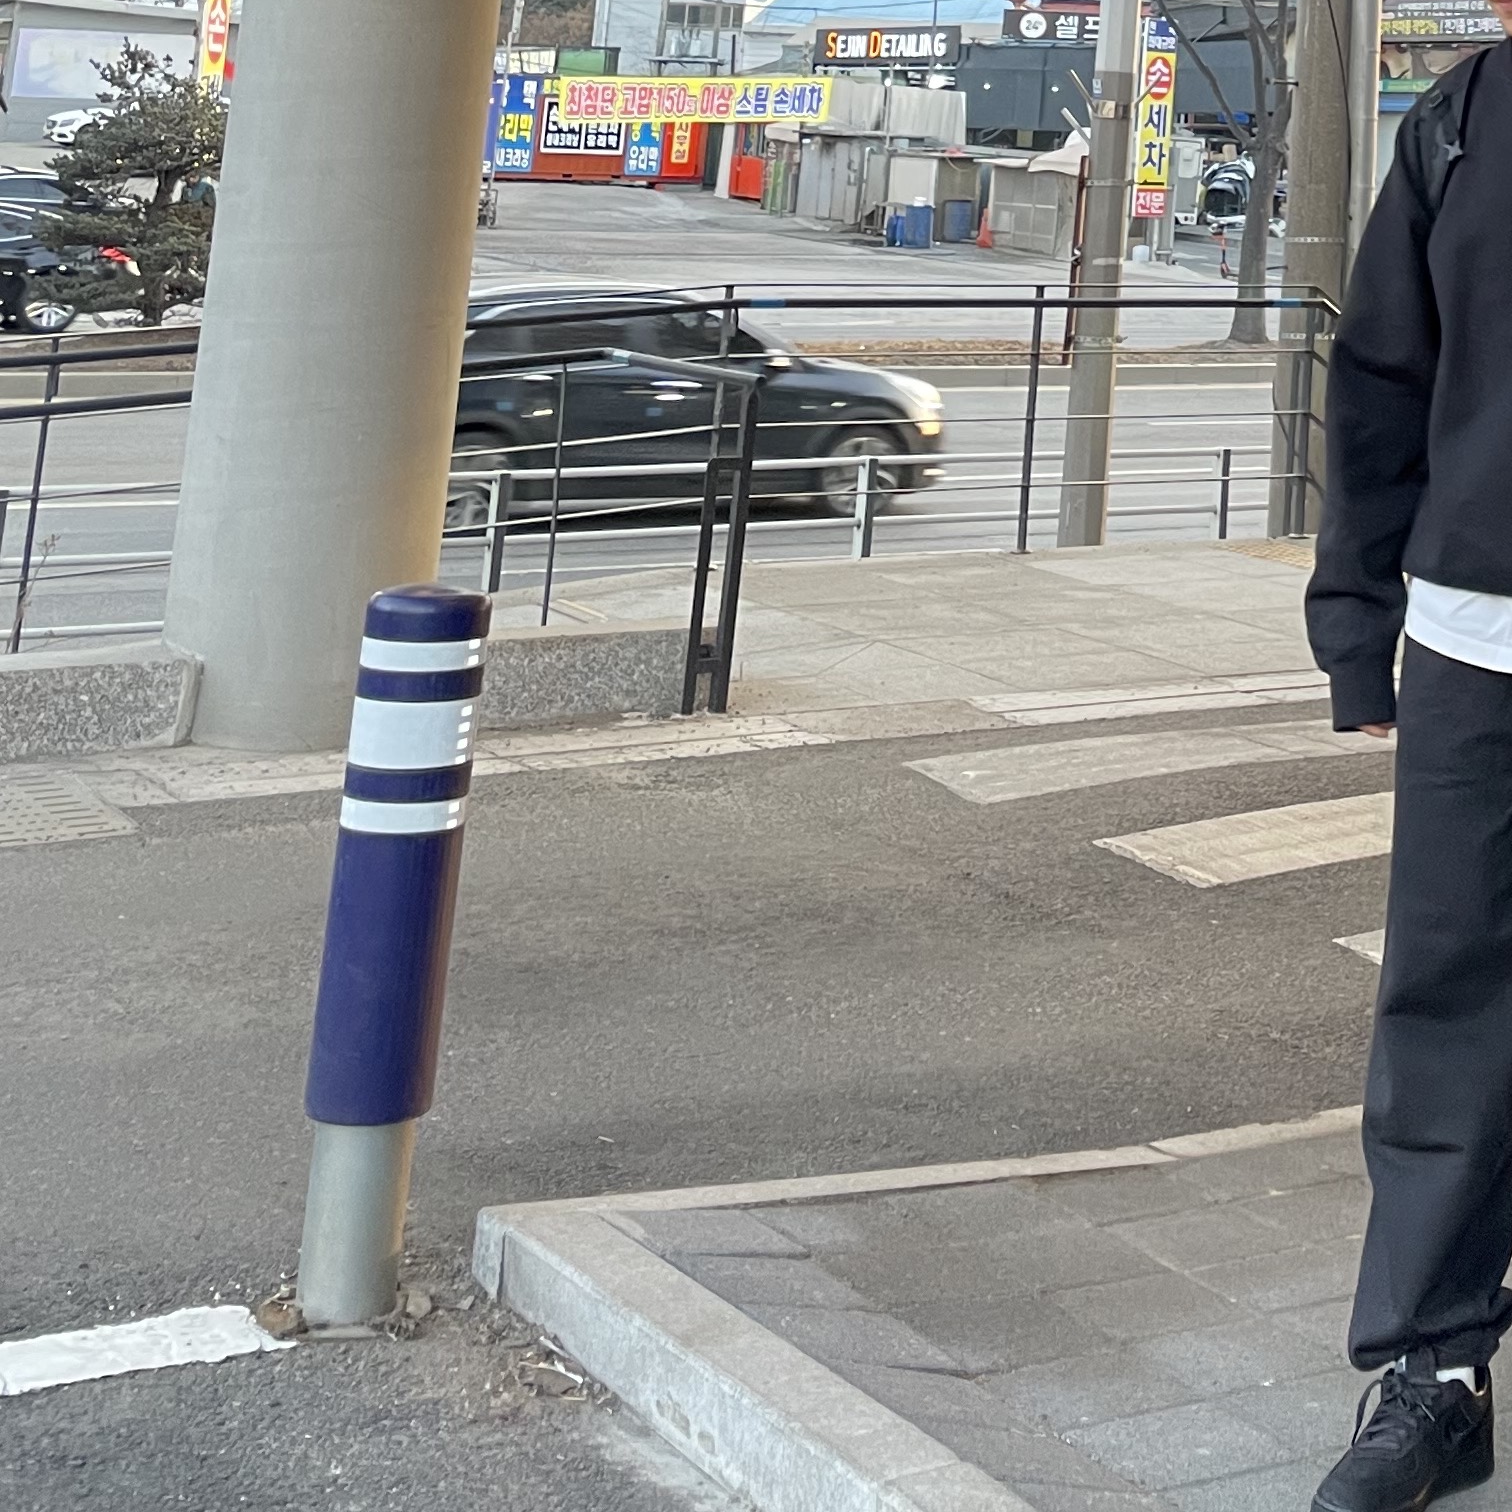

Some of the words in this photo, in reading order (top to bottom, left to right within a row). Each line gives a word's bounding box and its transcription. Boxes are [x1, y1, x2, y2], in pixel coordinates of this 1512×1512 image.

[825, 32, 867, 58] SEJIN
[869, 31, 947, 58] DETAILING
[565, 81, 618, 117] 최첨단
[700, 86, 734, 118] 이상
[735, 86, 769, 118] 스팀
[771, 85, 824, 119] 손세차
[628, 145, 659, 171] 유리막
[1136, 191, 1165, 214] 전문
